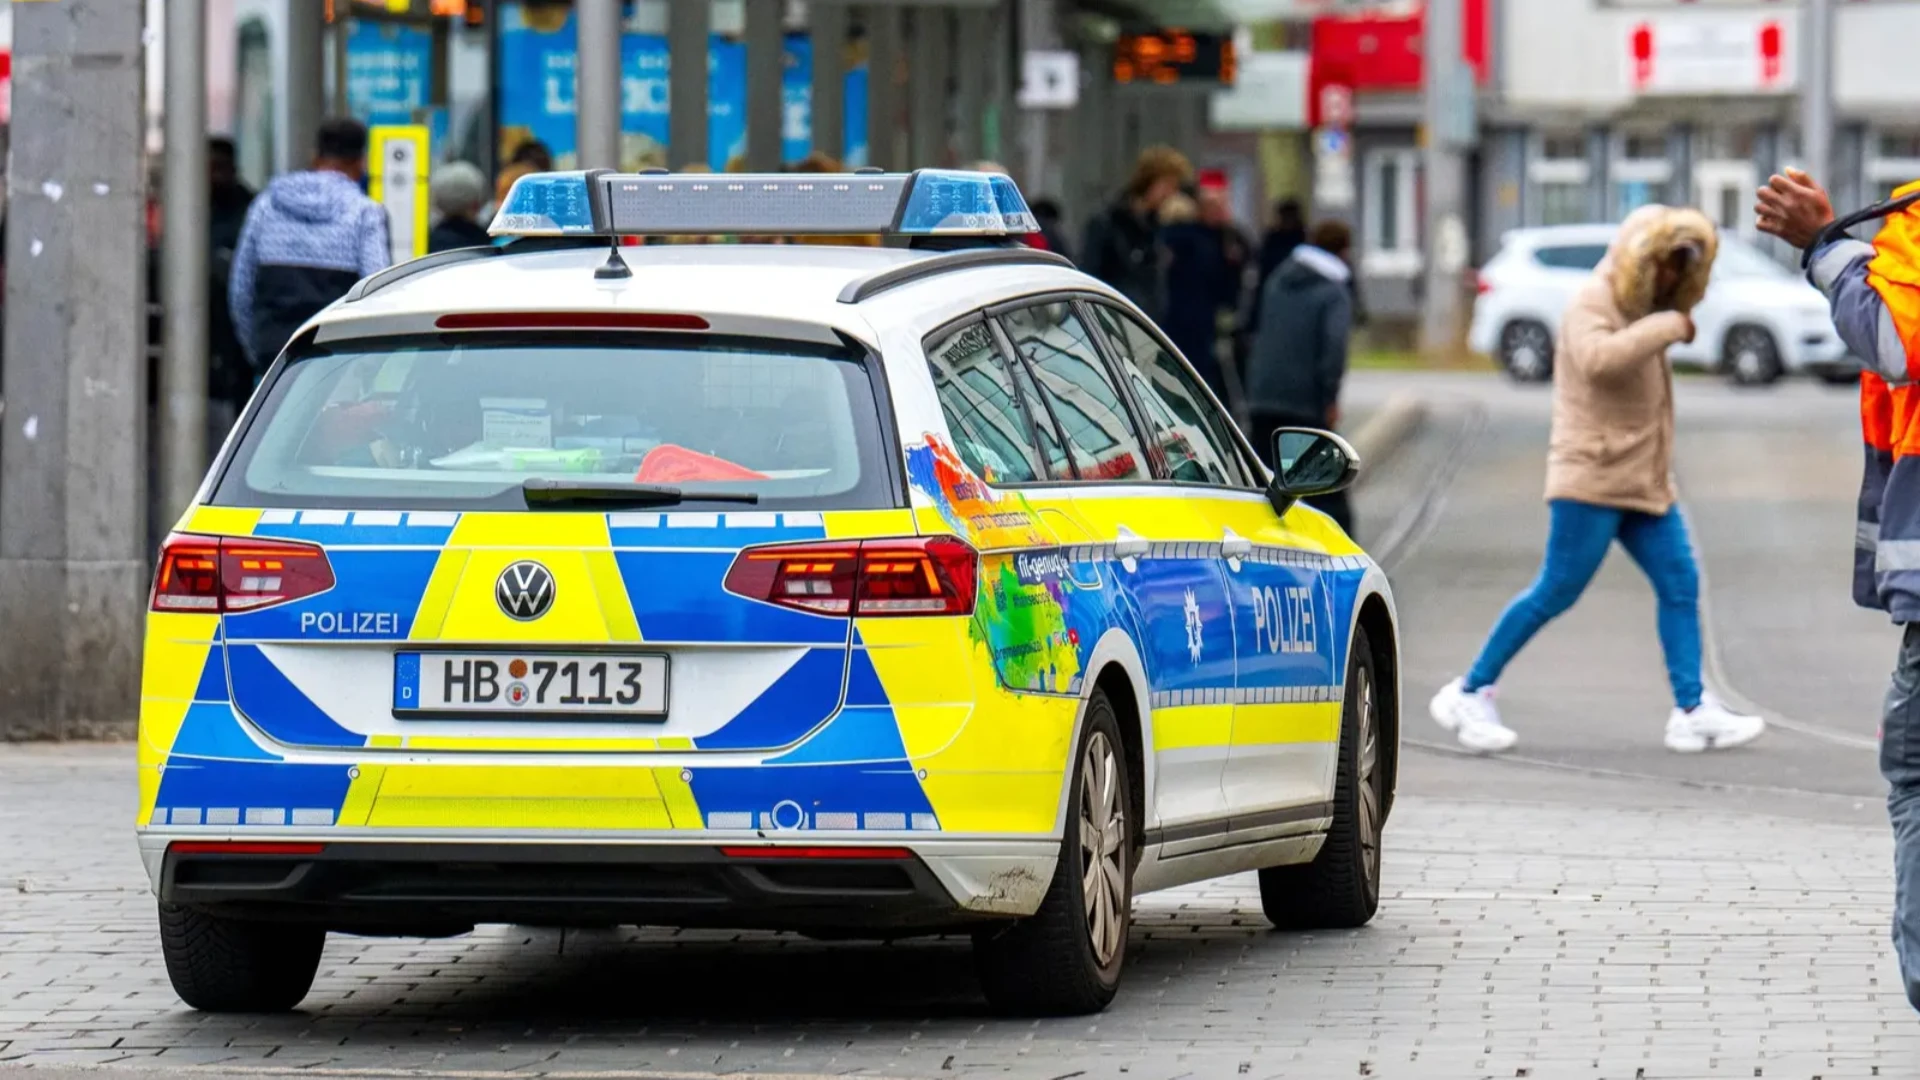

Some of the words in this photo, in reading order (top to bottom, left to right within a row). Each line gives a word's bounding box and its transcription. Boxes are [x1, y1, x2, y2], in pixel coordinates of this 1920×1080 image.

[498, 562, 553, 616] VW
[301, 612, 398, 633] POLIZEI
[1251, 585, 1317, 655] POLIZEI
[402, 686, 412, 699] D
[443, 660, 500, 703] HB
[533, 661, 642, 704] 7113
